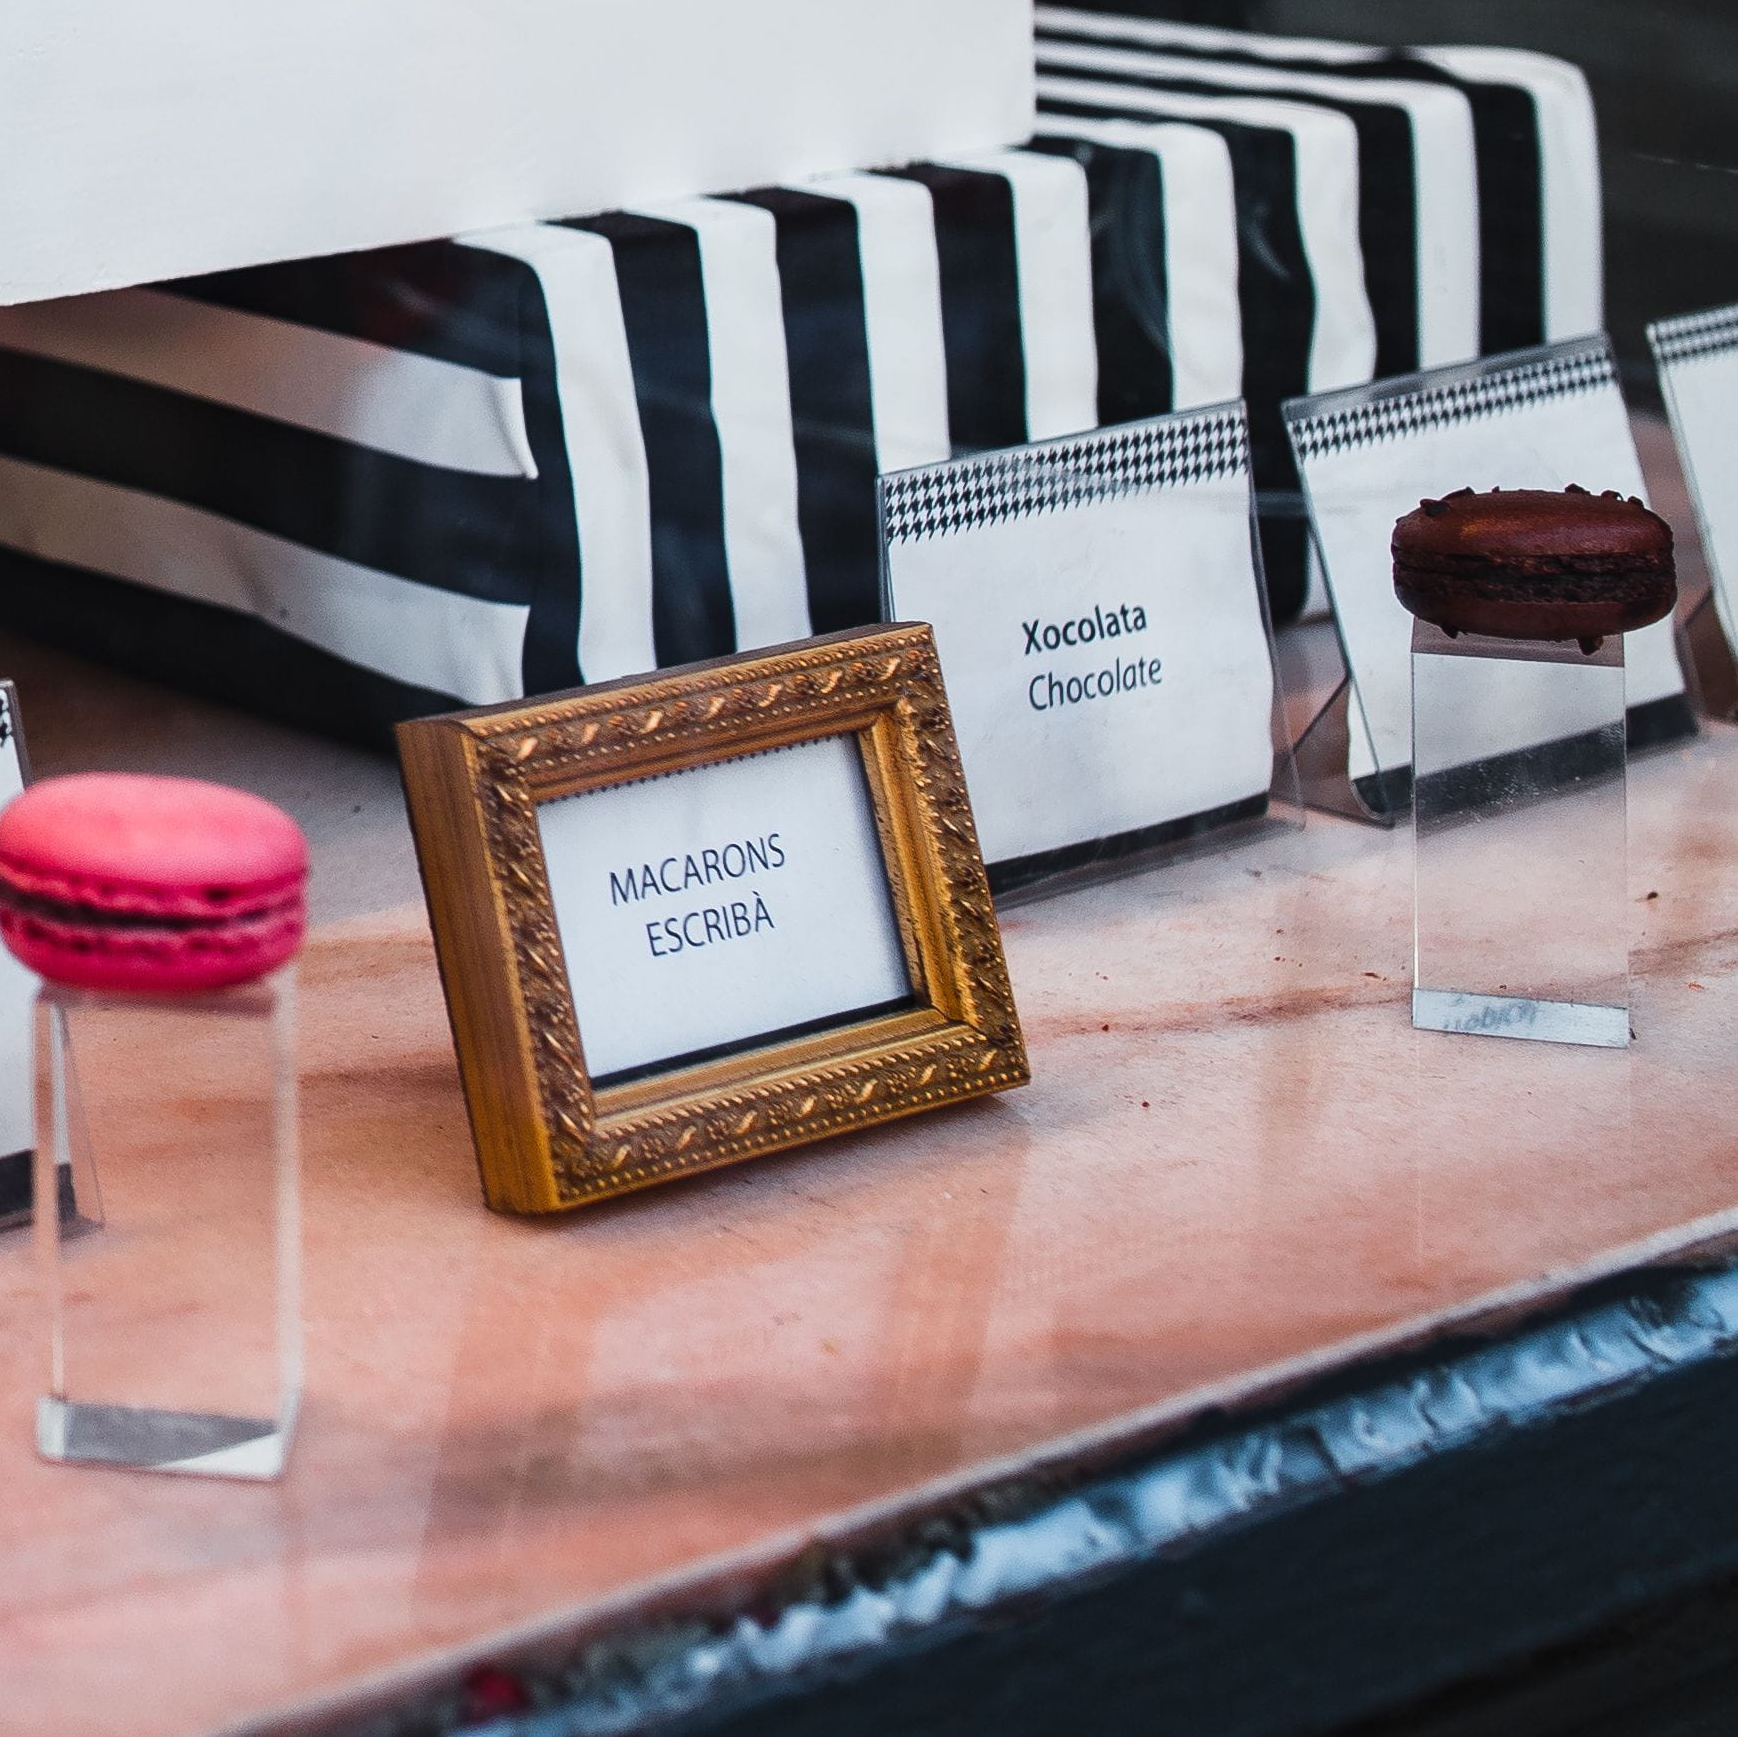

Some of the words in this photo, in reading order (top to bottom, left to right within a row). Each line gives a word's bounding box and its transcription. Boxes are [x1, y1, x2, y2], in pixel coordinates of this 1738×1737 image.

[1018, 600, 1149, 658] Xocolata
[1027, 654, 1165, 713] Chocolate
[606, 830, 787, 908] MACARONS
[642, 887, 777, 959] ESCRIBÀ
